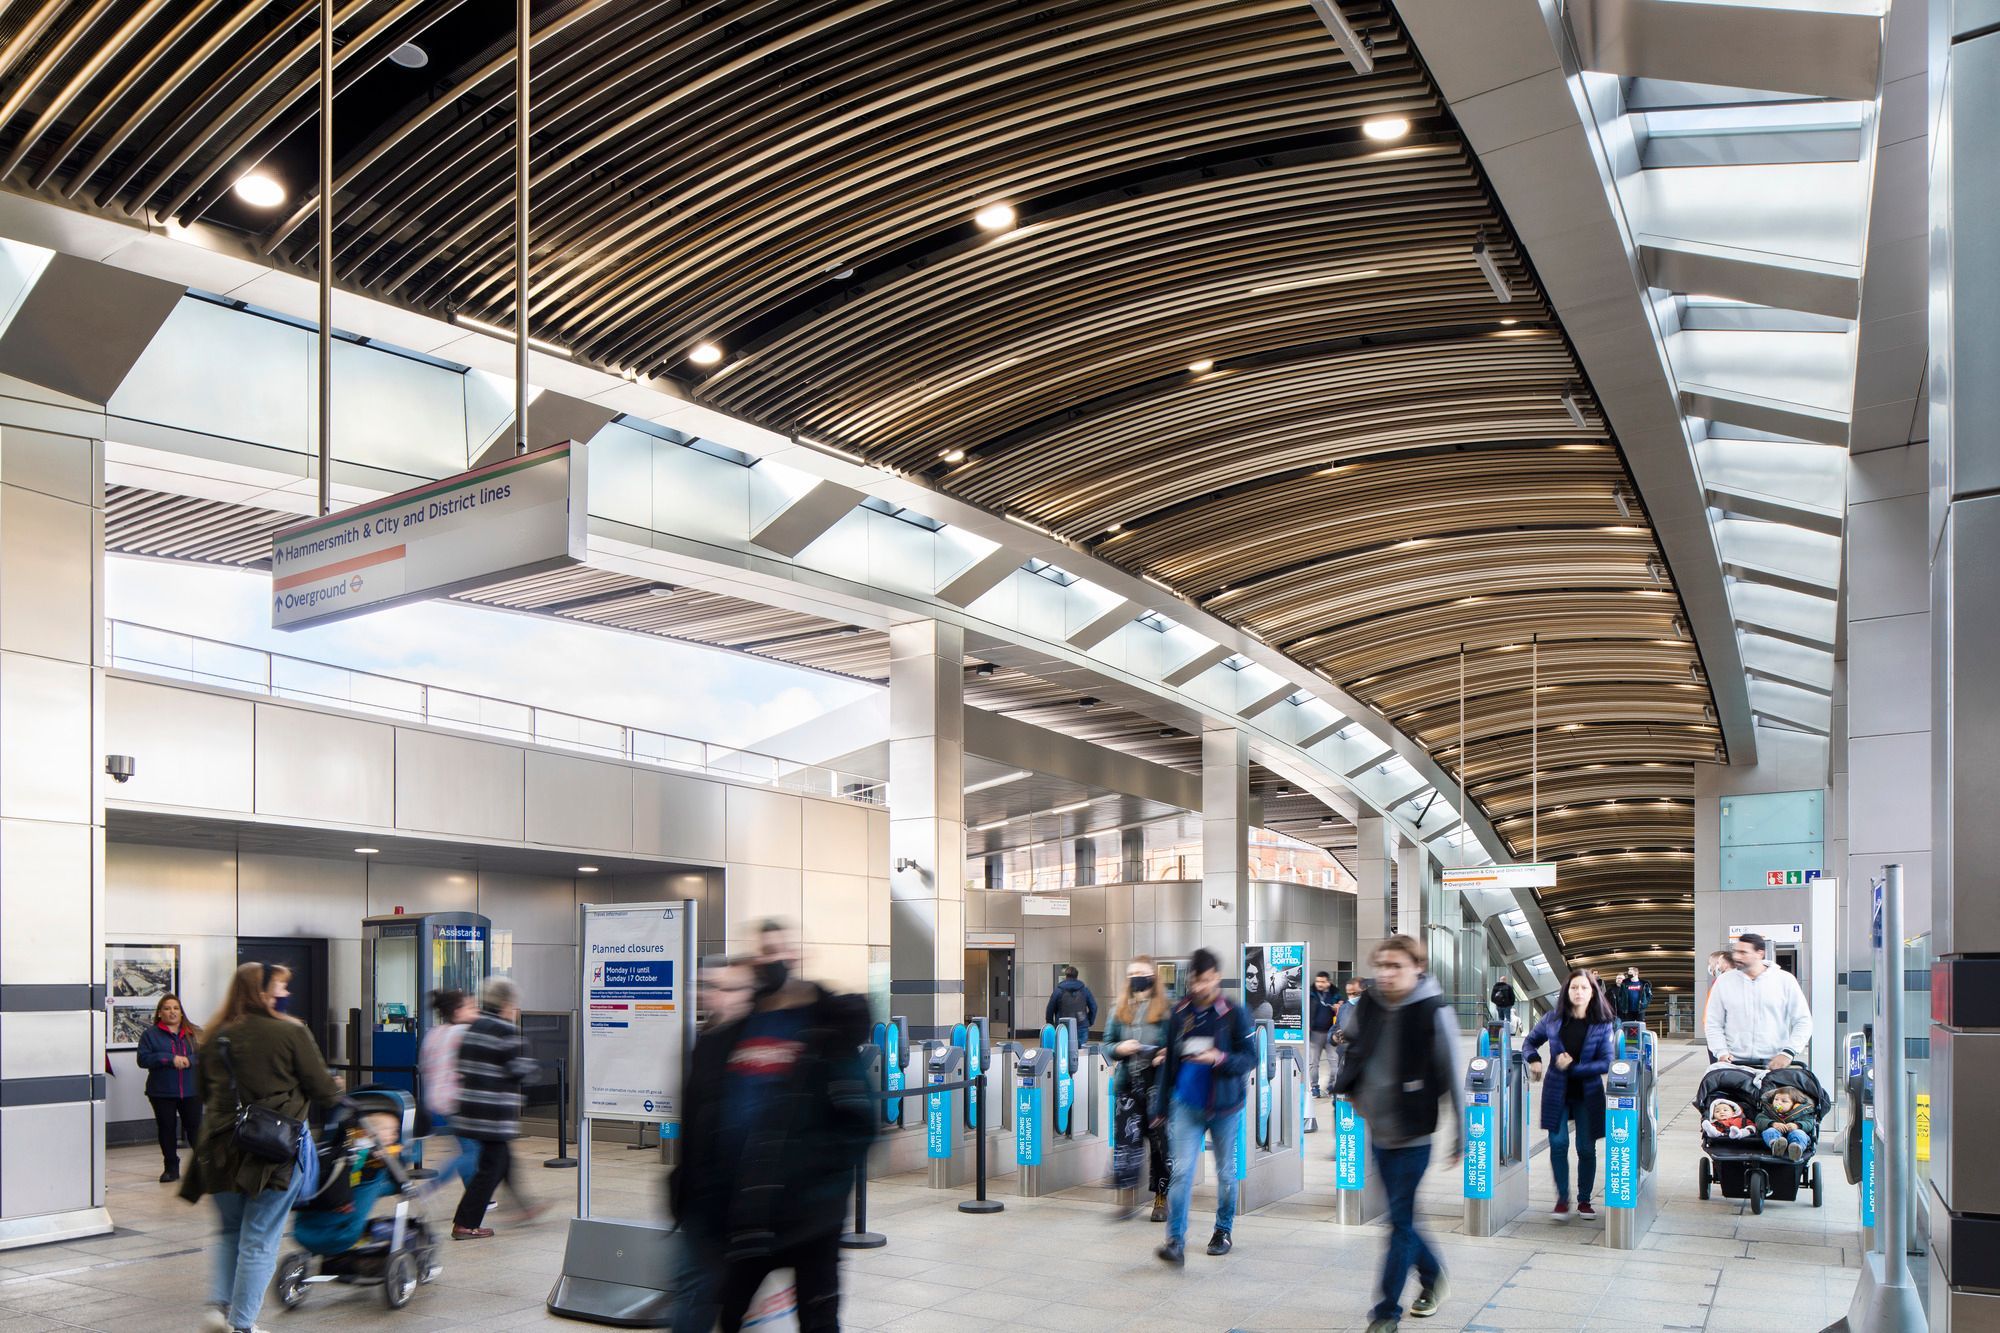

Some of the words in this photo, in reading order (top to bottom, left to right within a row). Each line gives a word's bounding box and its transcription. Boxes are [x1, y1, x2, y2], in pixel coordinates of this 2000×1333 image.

[285, 527, 359, 561] Hammersmith
[363, 522, 371, 538] &
[375, 517, 400, 534] City
[403, 506, 425, 527] and
[429, 493, 476, 519] District
[480, 484, 511, 504] lines
[285, 579, 346, 608] Overground
[439, 927, 480, 938] Assistance
[592, 944, 625, 953] Planned
[627, 943, 664, 953] closures
[606, 966, 628, 974] Monday
[606, 975, 627, 983] Sunday
[1478, 1141, 1486, 1169] SAVING
[1611, 1147, 1619, 1171] SINCE
[1621, 1147, 1630, 1178] SAVING
[1478, 1171, 1486, 1192] LIVES
[1611, 1173, 1619, 1194] 1984
[1621, 1180, 1630, 1201] LIVES
